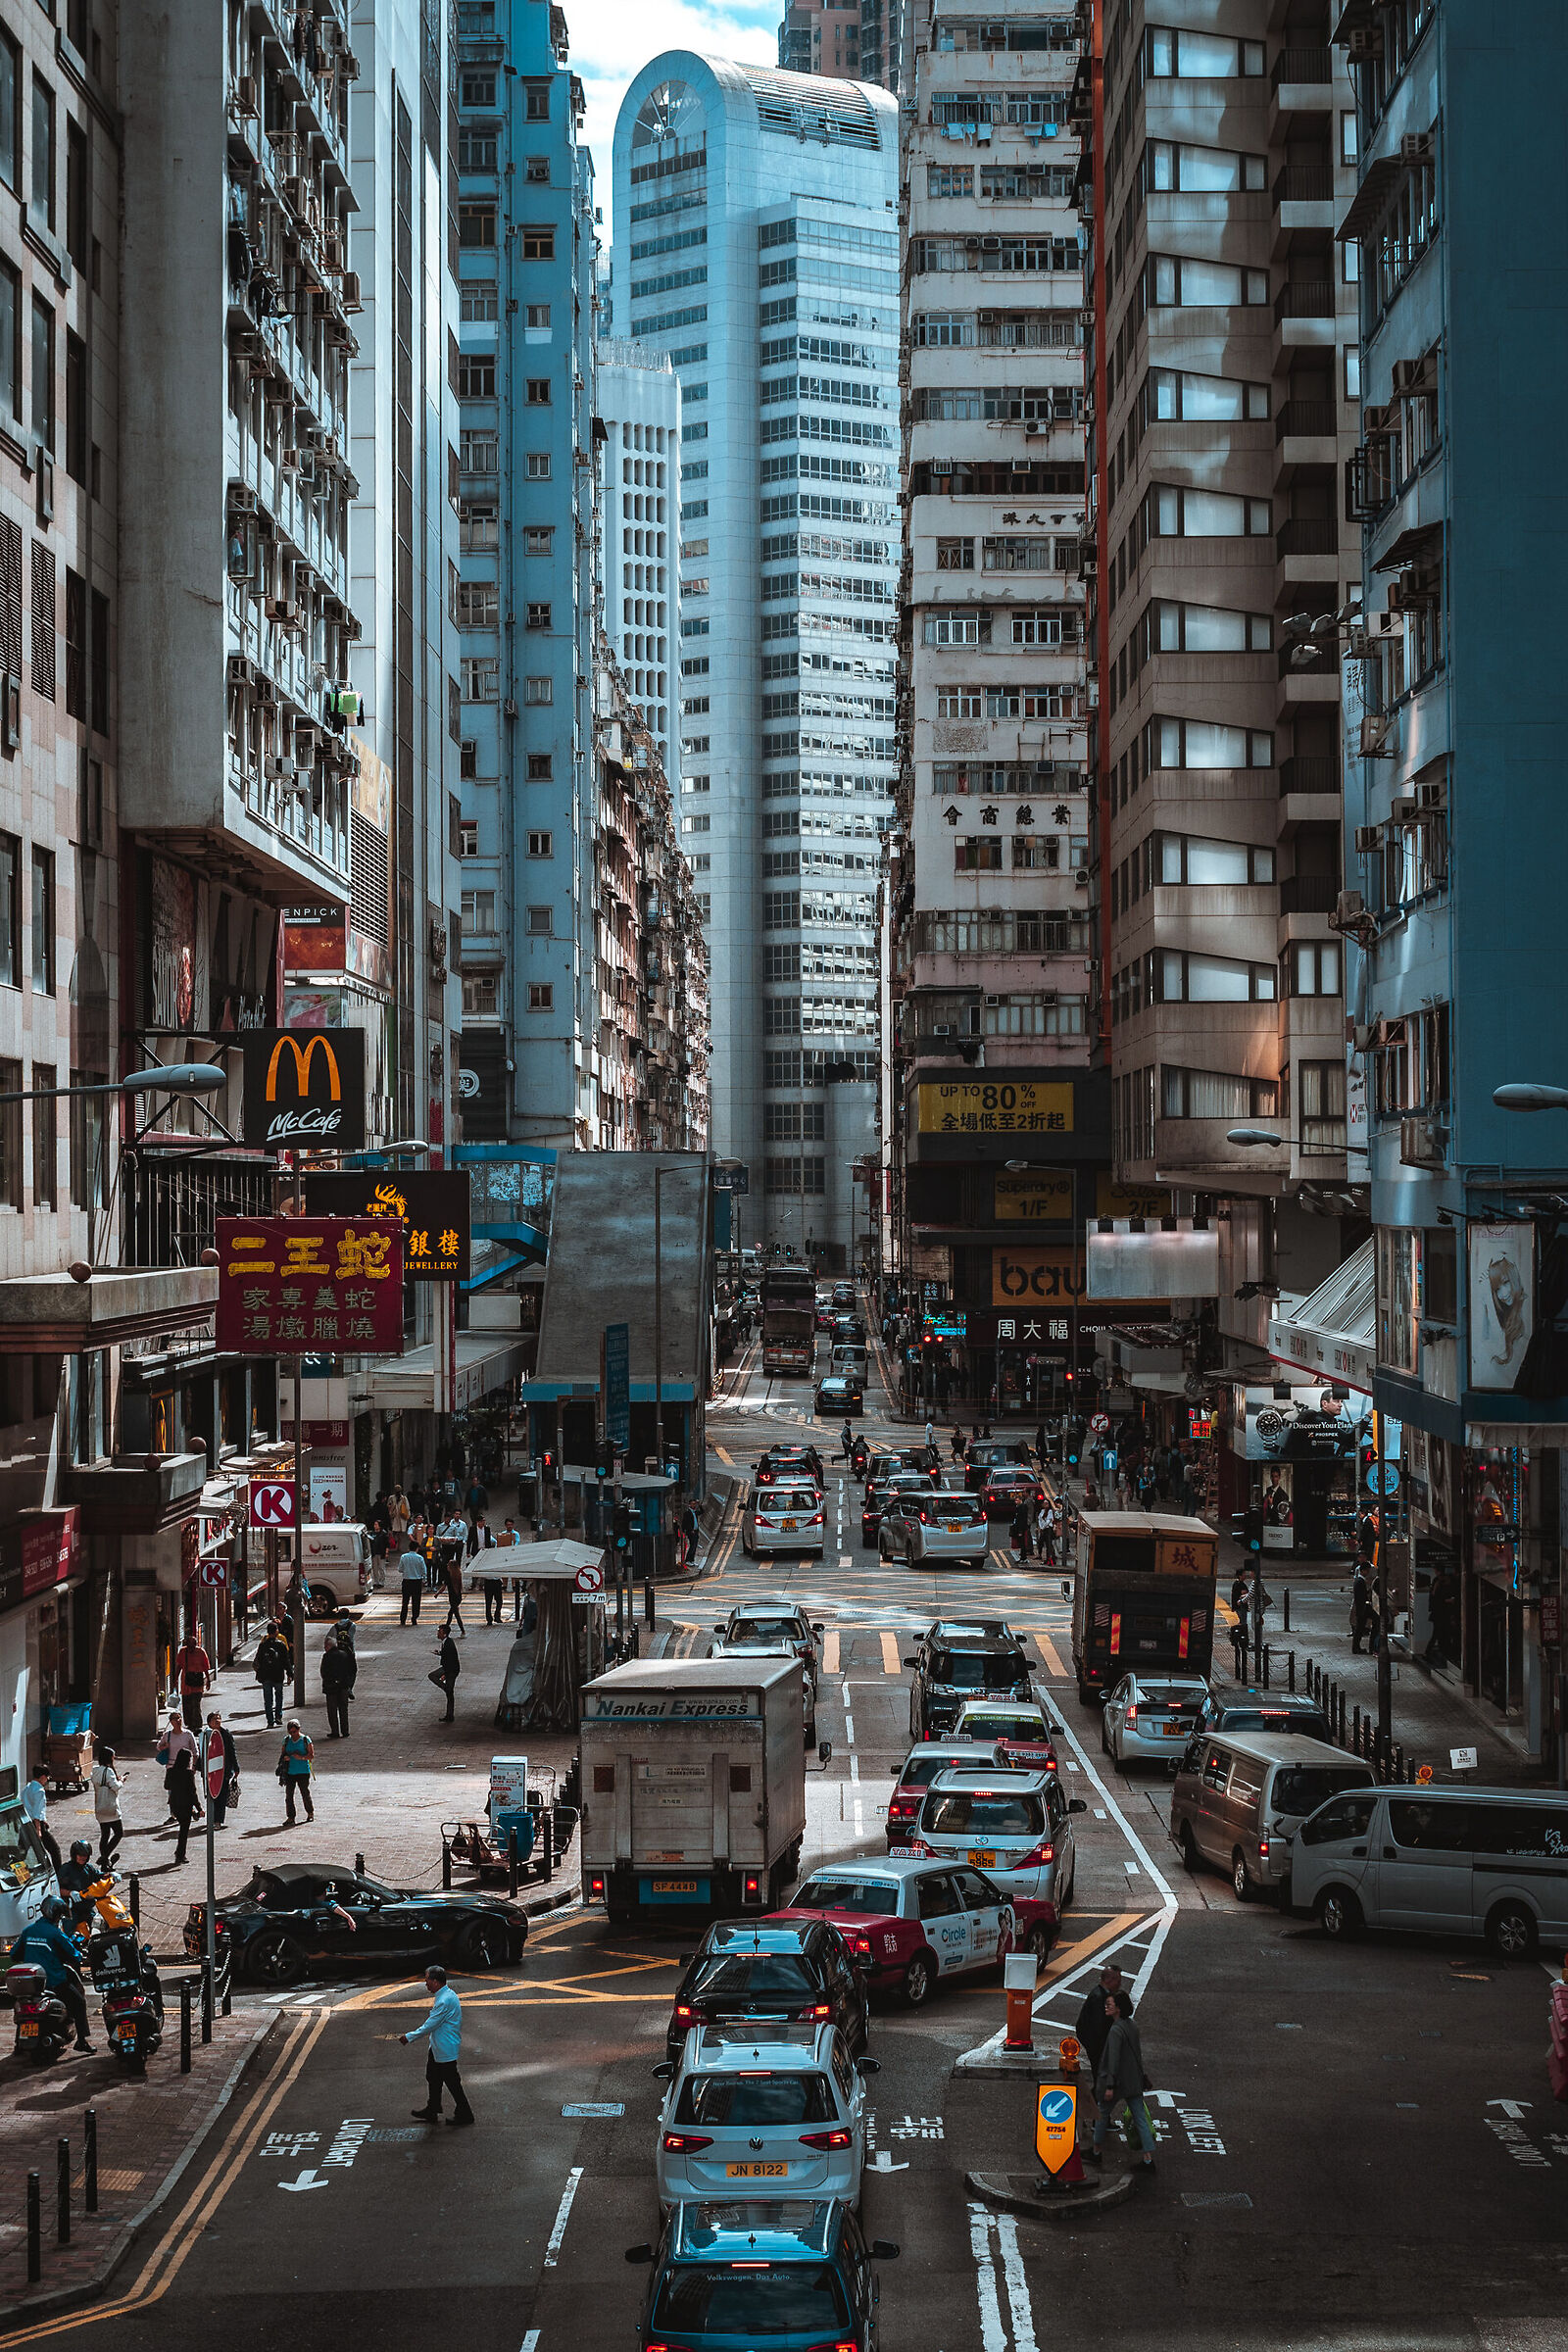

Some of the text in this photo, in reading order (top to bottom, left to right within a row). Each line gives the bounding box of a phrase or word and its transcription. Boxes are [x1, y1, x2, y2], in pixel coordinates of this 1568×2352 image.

[940, 1086, 958, 1097] UP
[961, 1085, 980, 1097] TO
[267, 1107, 342, 1139] McCafé
[941, 1112, 1065, 1131] 全場低至2折起
[1019, 1200, 1048, 1216] 1/F
[1129, 1200, 1158, 1216] 2/F
[409, 1229, 461, 1257] 銀樓
[404, 1261, 459, 1270] JEWELLERY
[997, 1319, 1069, 1341] 周大福
[597, 1700, 749, 1717] Nankai Express
[892, 1847, 921, 1857] TAXI
[942, 1927, 966, 1942] Circle
[885, 1943, 898, 1954] TAXI
[95, 1967, 126, 1976] deliveroo
[1175, 2108, 1228, 2155] LOOK LEFT
[320, 2118, 376, 2168] LOOK RIGHT
[731, 2164, 784, 2176] JN 8122
